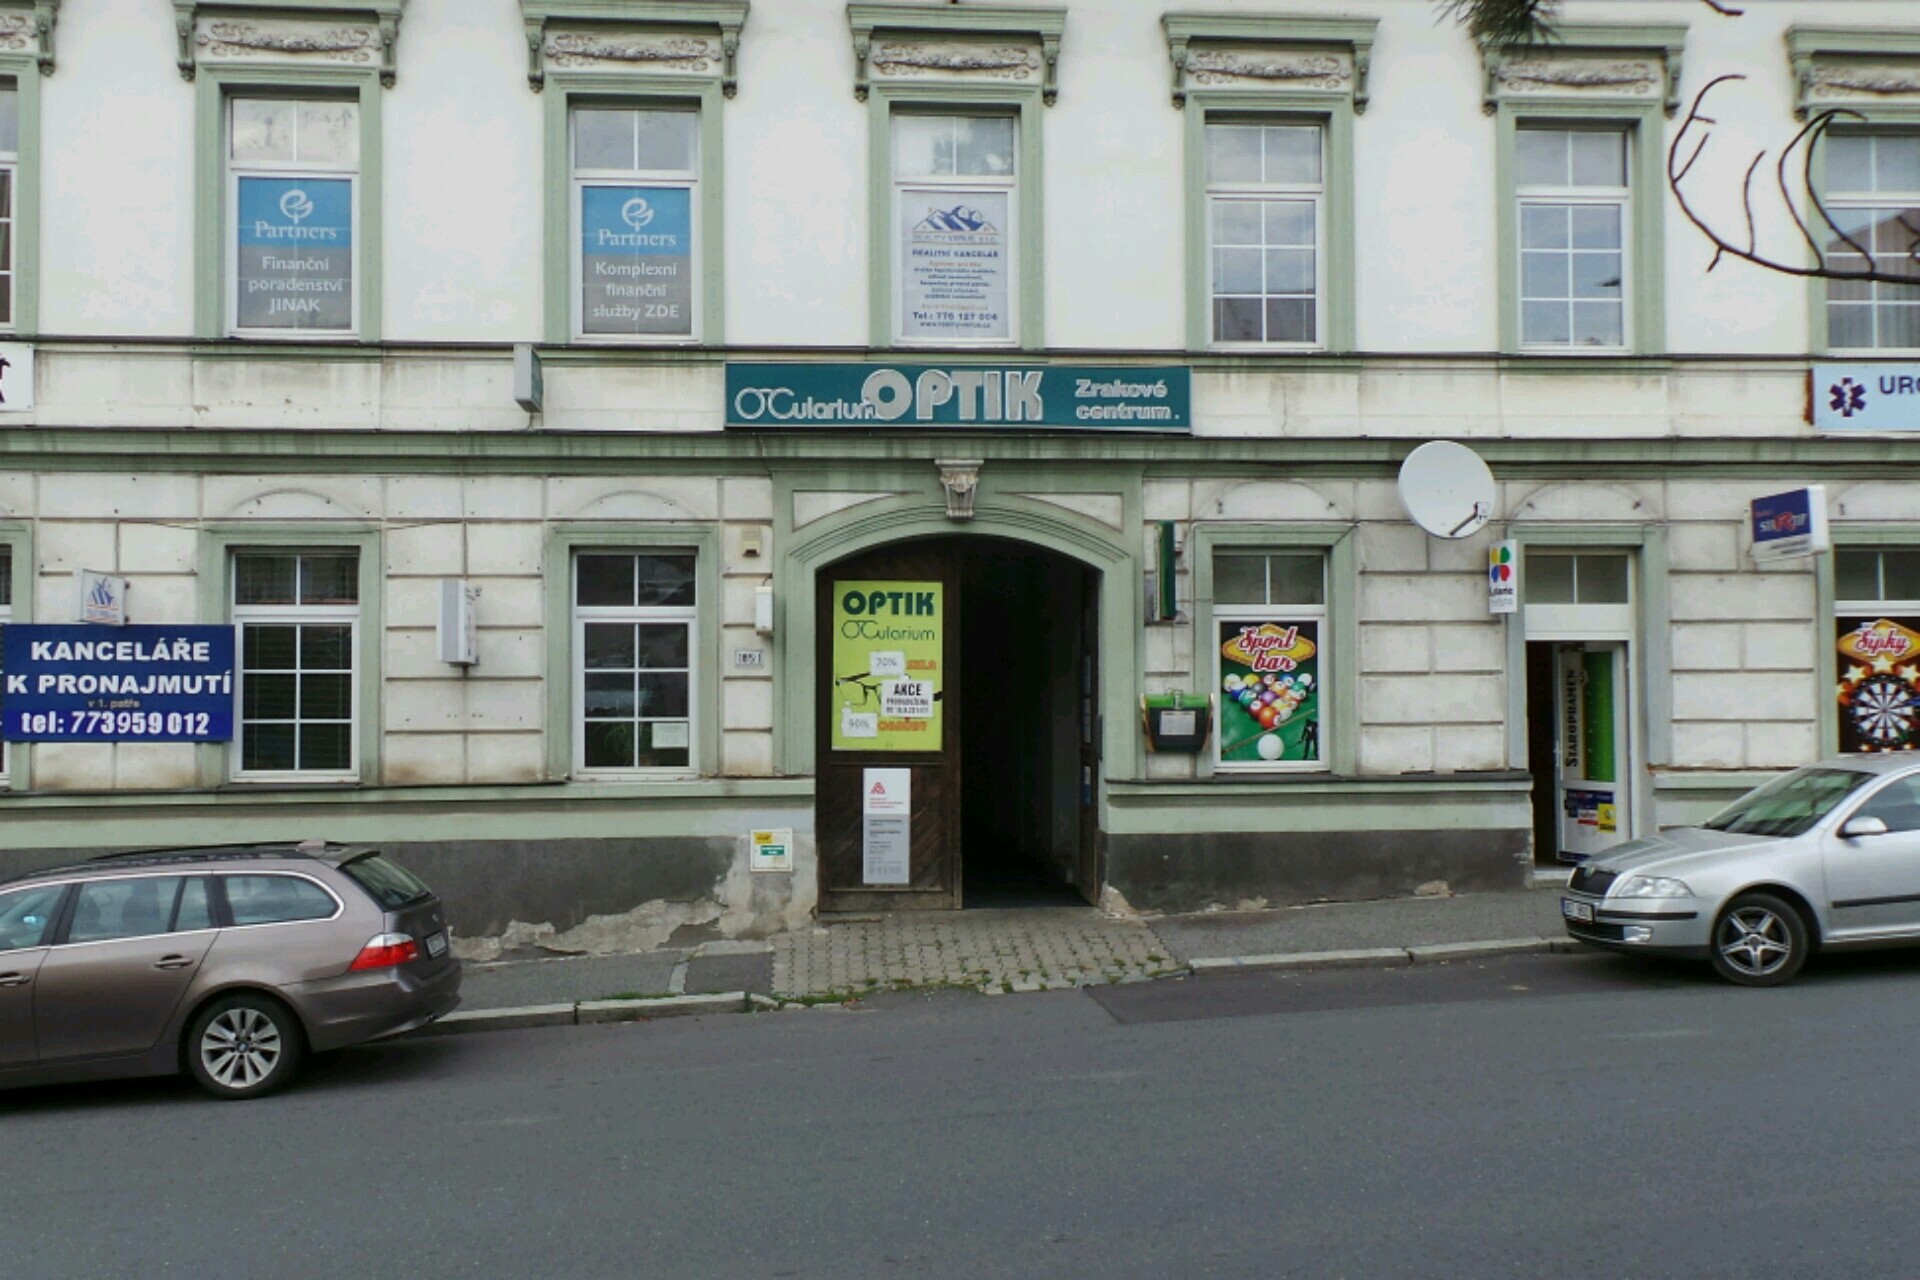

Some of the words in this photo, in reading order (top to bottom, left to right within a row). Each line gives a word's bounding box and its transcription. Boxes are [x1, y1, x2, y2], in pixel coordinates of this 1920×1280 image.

[254, 220, 337, 239] Partners
[598, 228, 677, 247] Partners
[262, 256, 330, 271] Finanční
[595, 262, 677, 278] Komplexní
[248, 279, 343, 293] poradenství
[605, 284, 667, 297] finanční
[268, 298, 321, 315] JINAK
[592, 304, 640, 321] služby
[645, 304, 680, 318] ZDE
[861, 368, 1043, 421] OPTIK
[1075, 378, 1168, 399] Zrakové
[842, 590, 935, 616] OPTIK
[31, 638, 210, 661] KANCELÁŘE
[1237, 626, 1298, 654] Sport
[1252, 650, 1297, 672] bar
[7, 675, 28, 694] K
[38, 669, 232, 694] PRONAJMUTÍ
[893, 683, 922, 696] AKCE
[21, 711, 65, 734] tel:
[1565, 669, 1579, 768] STAROPRAMEN
